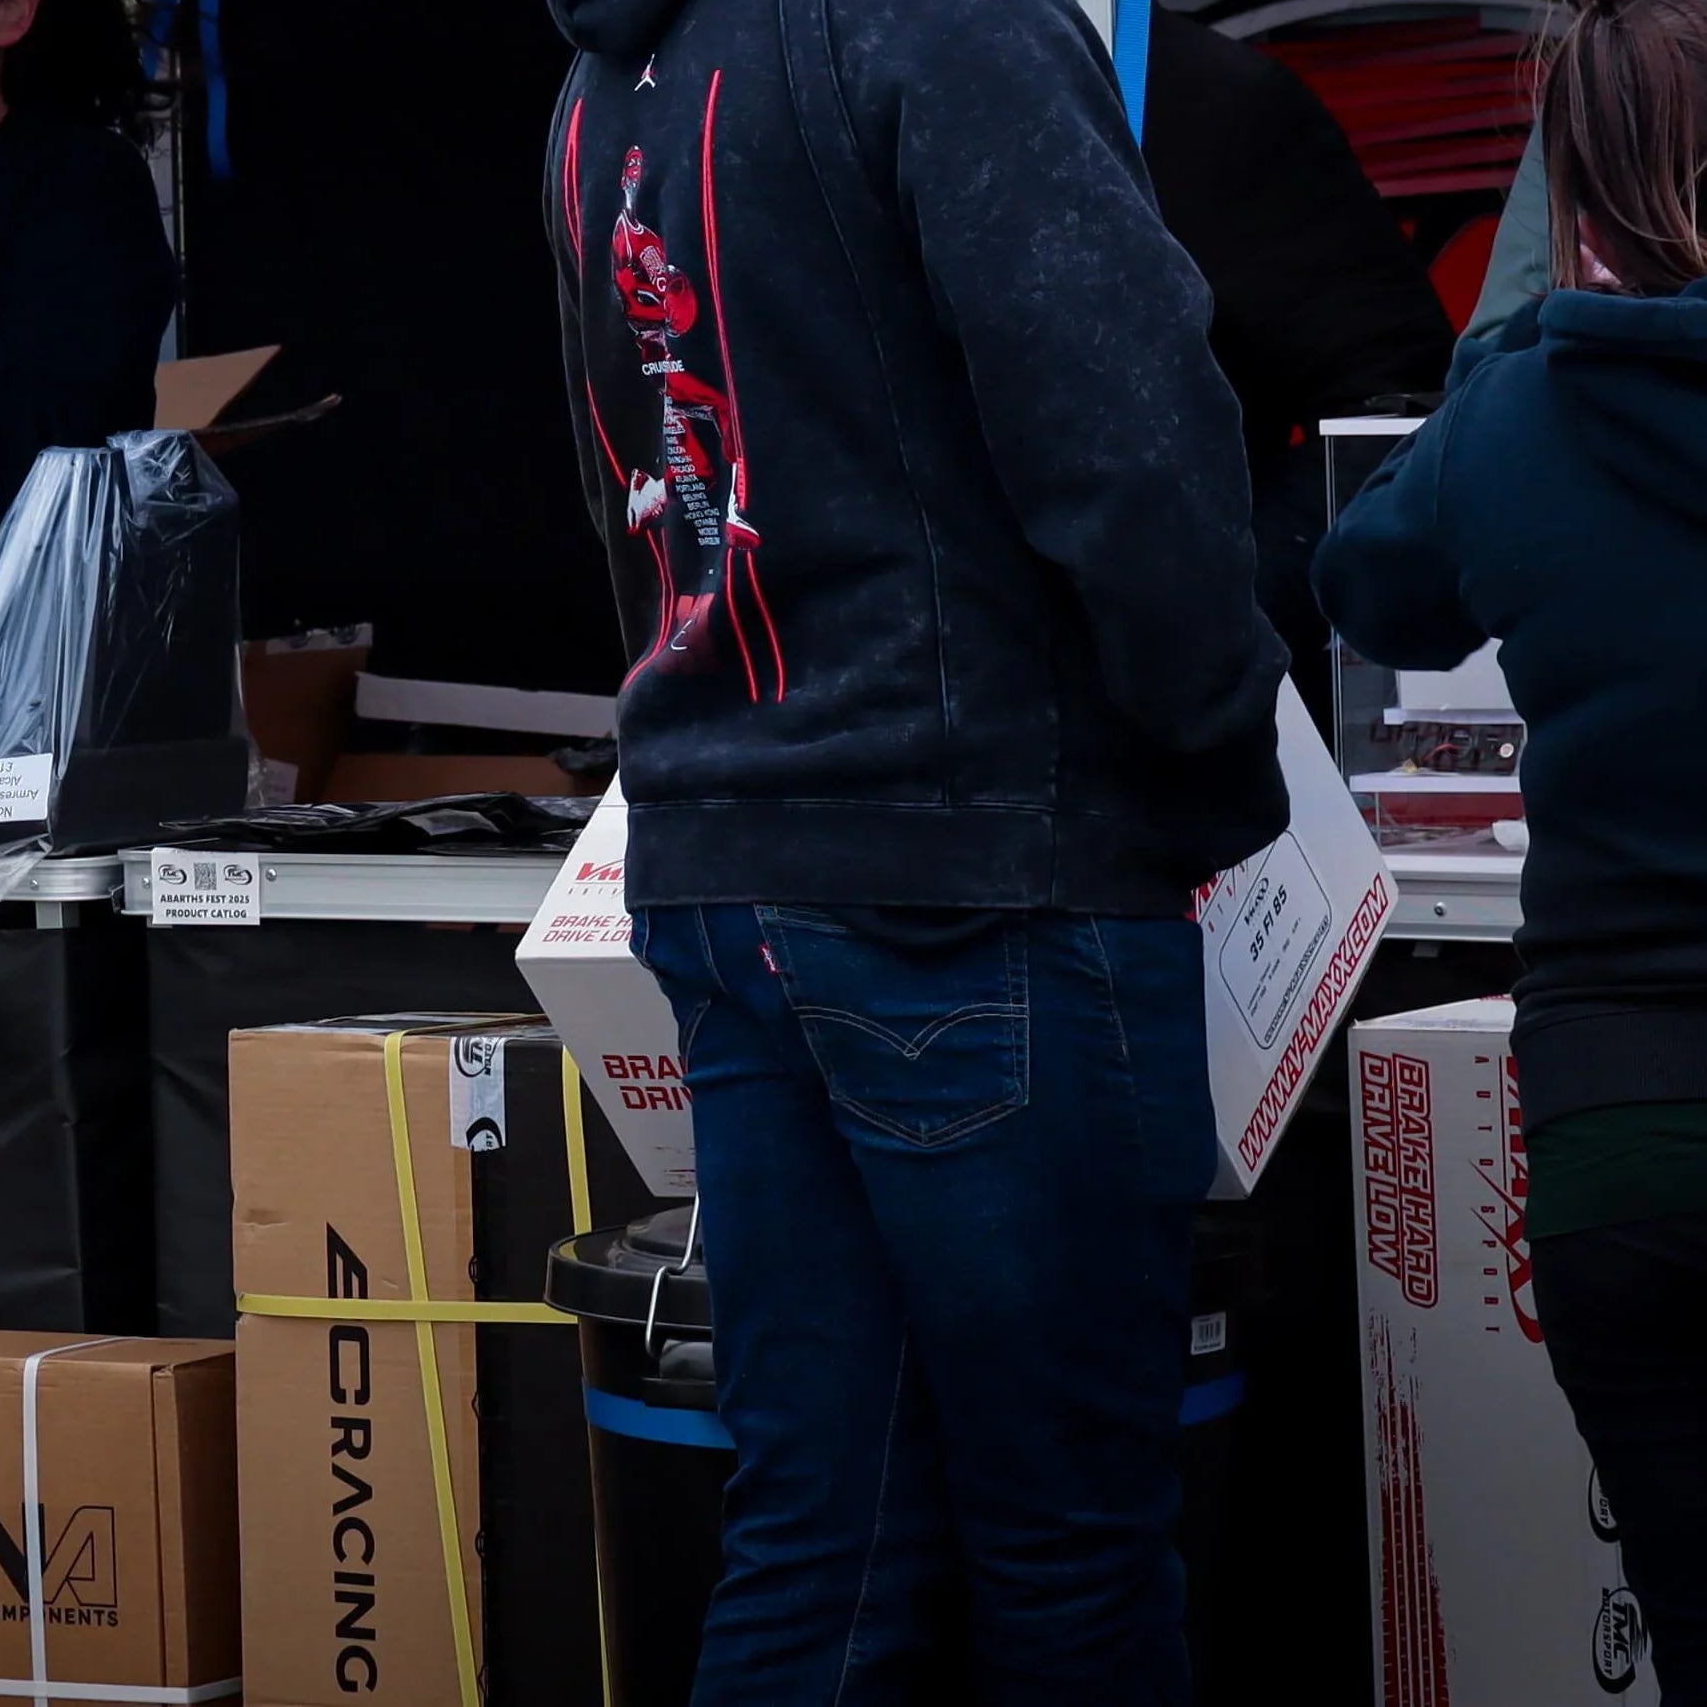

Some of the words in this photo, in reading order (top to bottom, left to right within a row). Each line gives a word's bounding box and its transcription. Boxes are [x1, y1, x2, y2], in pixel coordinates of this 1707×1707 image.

[160, 894, 204, 904] ABARTHS
[206, 895, 226, 904] FEST
[228, 895, 250, 904] 2025
[166, 909, 208, 918] PRODUCT
[210, 910, 247, 919] CATLOG
[550, 915, 615, 928] BRAKE
[542, 930, 600, 943] DRIVE
[602, 1055, 685, 1079] BRA
[620, 1085, 692, 1111] DRI
[1360, 1052, 1396, 1176] DRIVE
[1393, 1054, 1434, 1193] BRAKE
[1366, 1178, 1401, 1279] LOW
[1401, 1196, 1438, 1308] HARD
[1612, 1601, 1631, 1664] TMC
